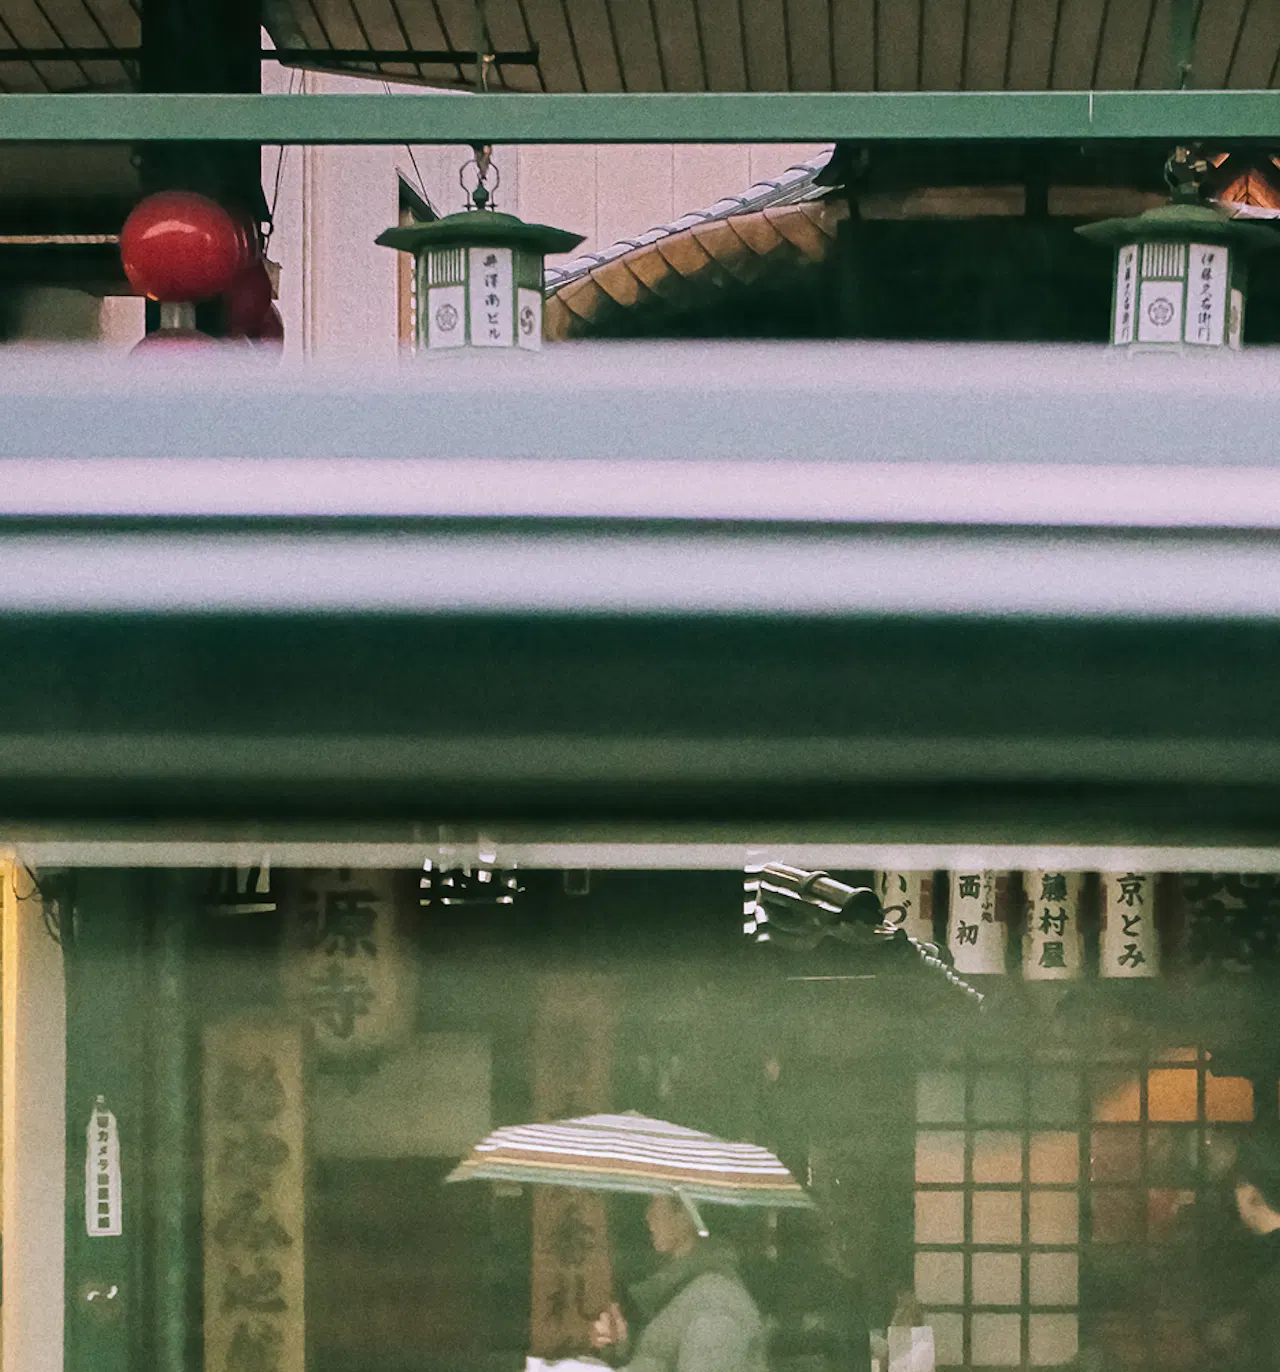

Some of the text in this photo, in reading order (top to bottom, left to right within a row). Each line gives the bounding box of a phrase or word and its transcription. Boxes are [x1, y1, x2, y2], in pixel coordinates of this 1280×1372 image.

[300, 869, 381, 1040] 源寺
[956, 874, 981, 946] 西初
[1038, 872, 1070, 969] 藤村屋
[1116, 872, 1146, 969] 京とみ
